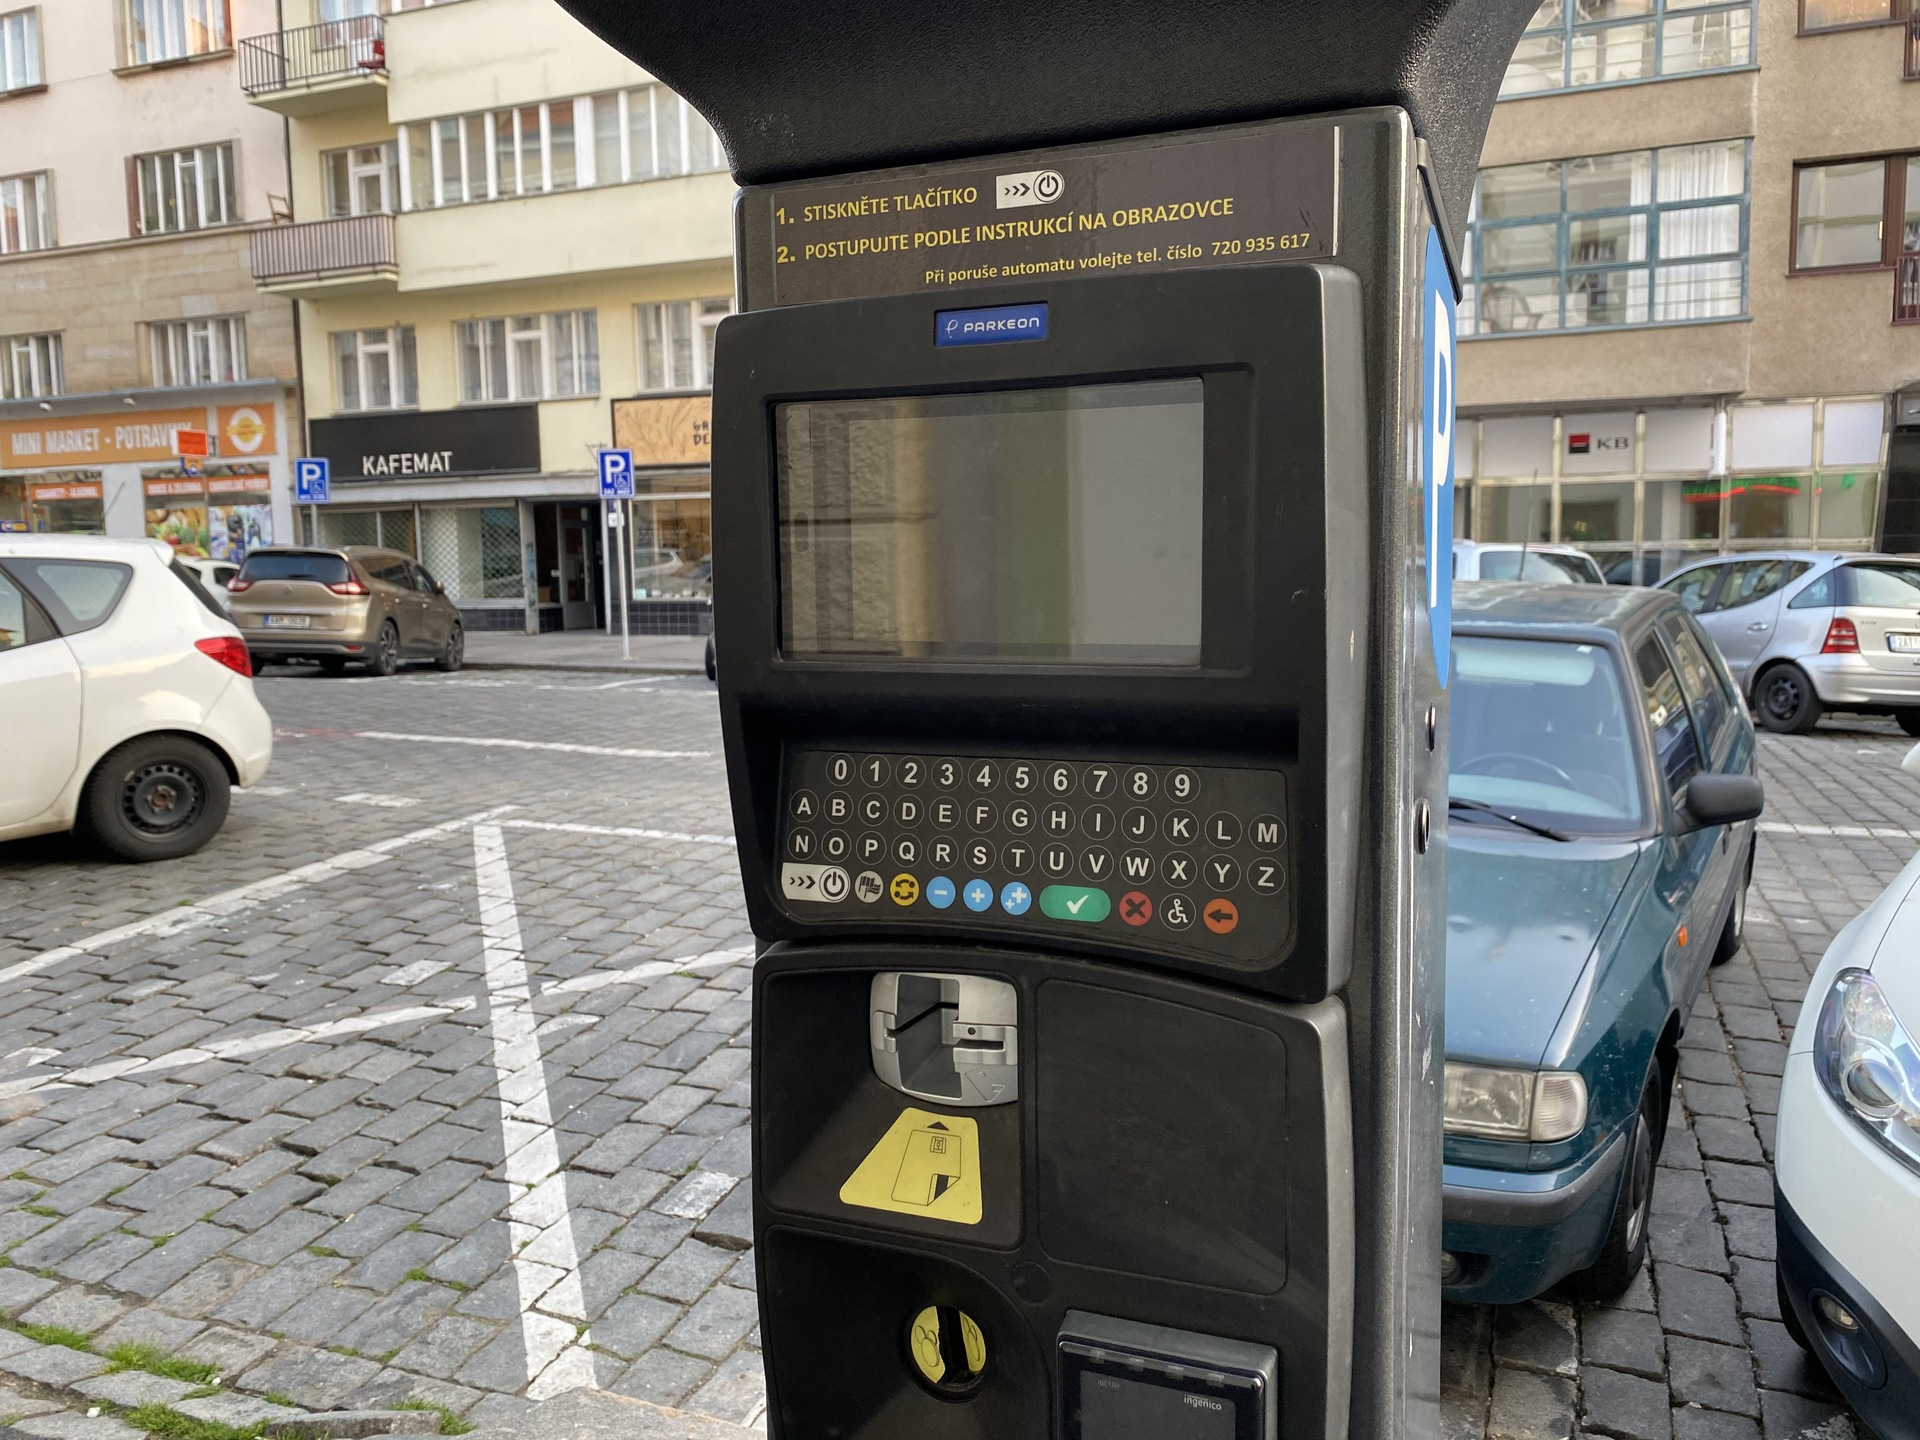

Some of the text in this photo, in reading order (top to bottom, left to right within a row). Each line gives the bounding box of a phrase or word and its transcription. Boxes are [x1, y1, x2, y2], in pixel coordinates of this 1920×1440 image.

[776, 186, 978, 225] 1. STISKNĚTE TLAČÍTKO
[776, 198, 1234, 264] 2. POSTUPUJTE PODLE INSTRUKCÍ NA OBRAZOVCE
[925, 232, 1311, 284] Při poruše automatu volejte tel. číslo 720 935 617
[963, 317, 1040, 333] PARKEON
[11, 431, 42, 456] MINI
[45, 427, 101, 454] MARKET
[114, 421, 192, 450] POTRAV
[1597, 436, 1629, 450] KB
[302, 463, 322, 490] P
[362, 451, 453, 476] KAFEMAT
[604, 454, 626, 484] P
[834, 759, 1190, 797] 0 1 2 3 4 5 6 7 8 9
[797, 797, 812, 815] A
[831, 798, 846, 816] B
[866, 800, 881, 819] C
[902, 802, 916, 820] D
[938, 804, 952, 823] E
[976, 806, 989, 825] F
[1011, 808, 1028, 827] G
[1051, 810, 1067, 830] H
[1132, 815, 1145, 835] J
[1173, 817, 1190, 838] K
[1217, 820, 1232, 840] L
[1257, 822, 1278, 843] M
[795, 835, 1274, 887] N O P Q R S T U V W X Y Z
[1183, 1394, 1222, 1411] ingenico
